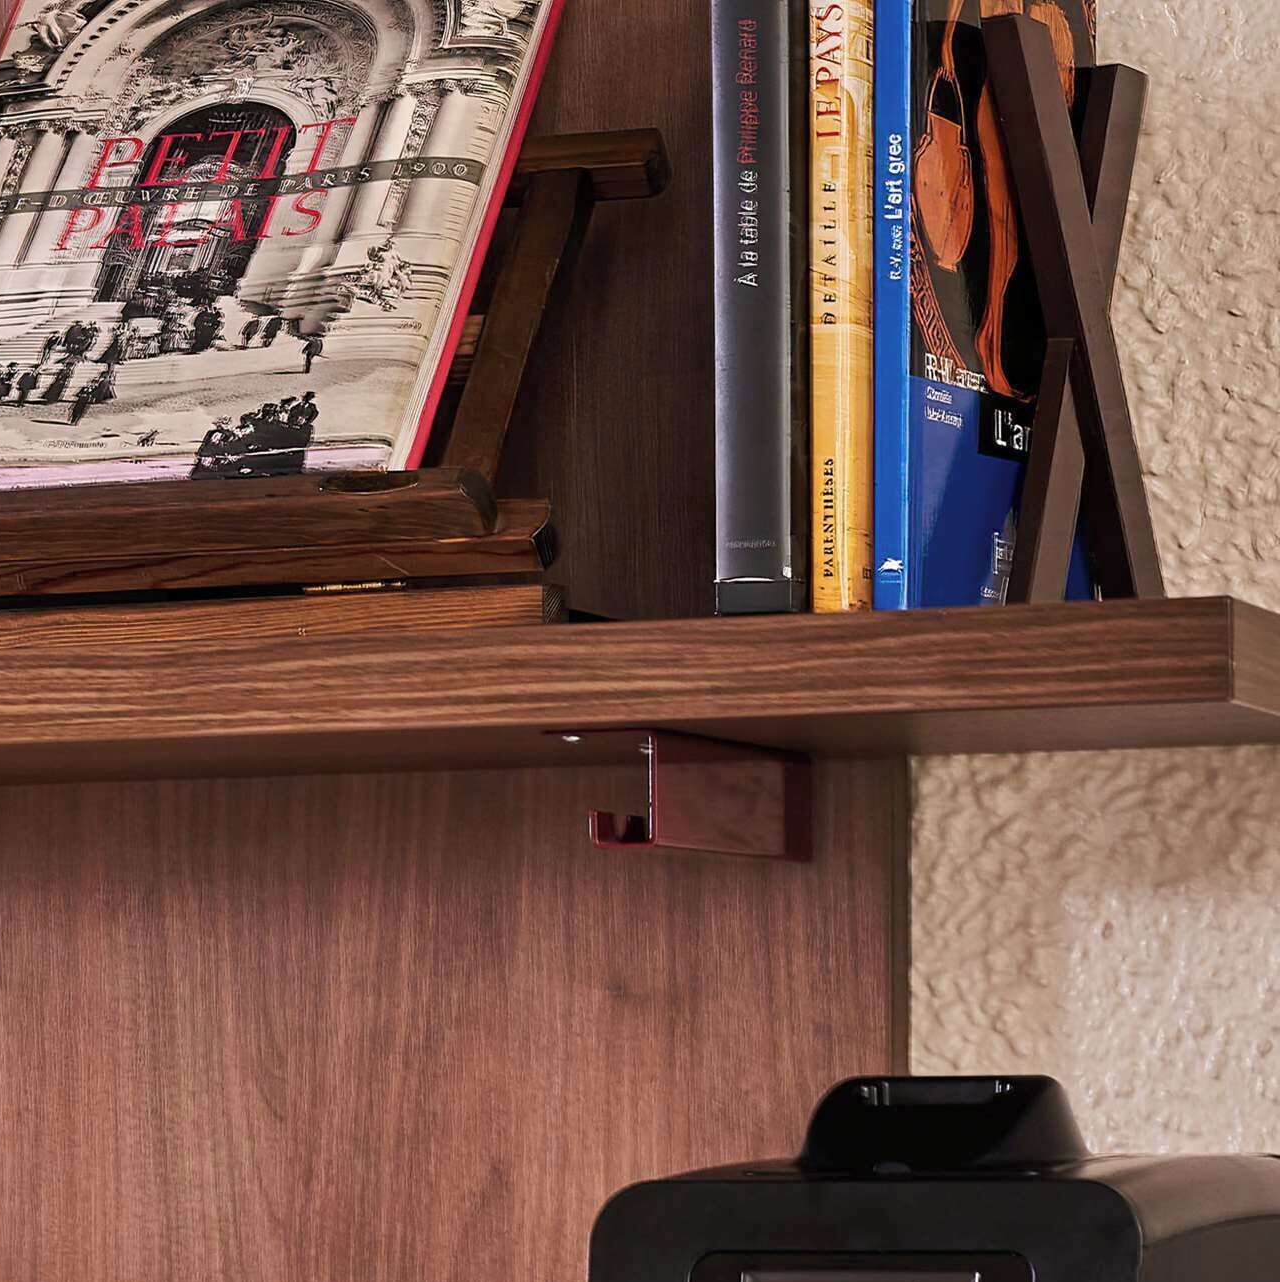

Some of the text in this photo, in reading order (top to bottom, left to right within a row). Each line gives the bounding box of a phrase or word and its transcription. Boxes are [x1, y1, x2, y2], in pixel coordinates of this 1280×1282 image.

[815, 3, 844, 139] LE PAYS
[737, 90, 760, 164] Philippe
[80, 117, 358, 191] PETIT
[889, 133, 906, 174] grec
[220, 184, 261, 198] DE
[280, 166, 373, 192] PARIS
[393, 162, 467, 176] 1900
[738, 170, 758, 193] de
[884, 179, 904, 220] L'art
[49, 188, 329, 251] PALAIS
[738, 200, 759, 244] table
[738, 250, 759, 267] la
